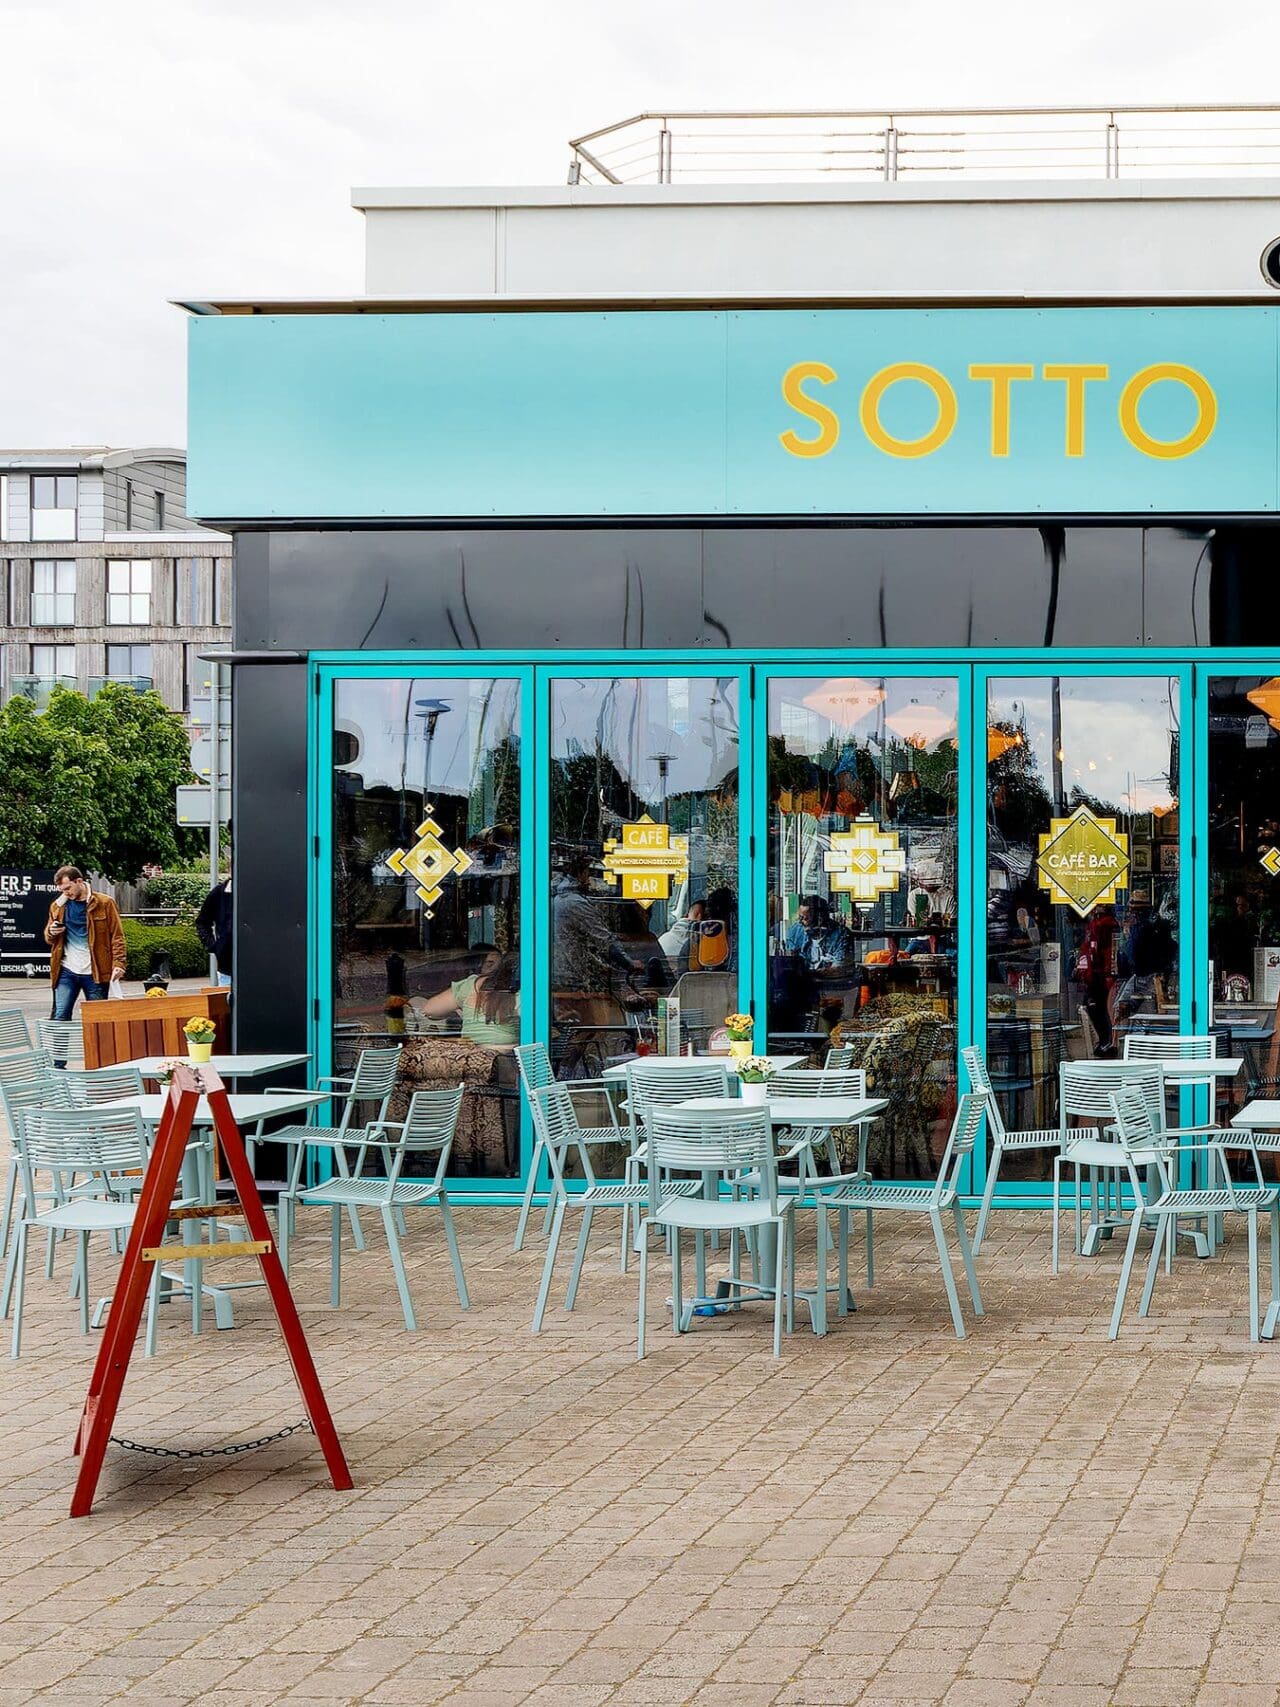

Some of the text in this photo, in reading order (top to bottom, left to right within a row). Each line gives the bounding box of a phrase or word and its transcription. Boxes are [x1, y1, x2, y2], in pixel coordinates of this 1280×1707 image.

[779, 359, 1219, 461] SOTTO
[628, 827, 664, 846] CAFÉ
[1048, 851, 1118, 868] CAFÉ BAR
[22, 875, 32, 891] 5
[632, 878, 658, 894] BAR
